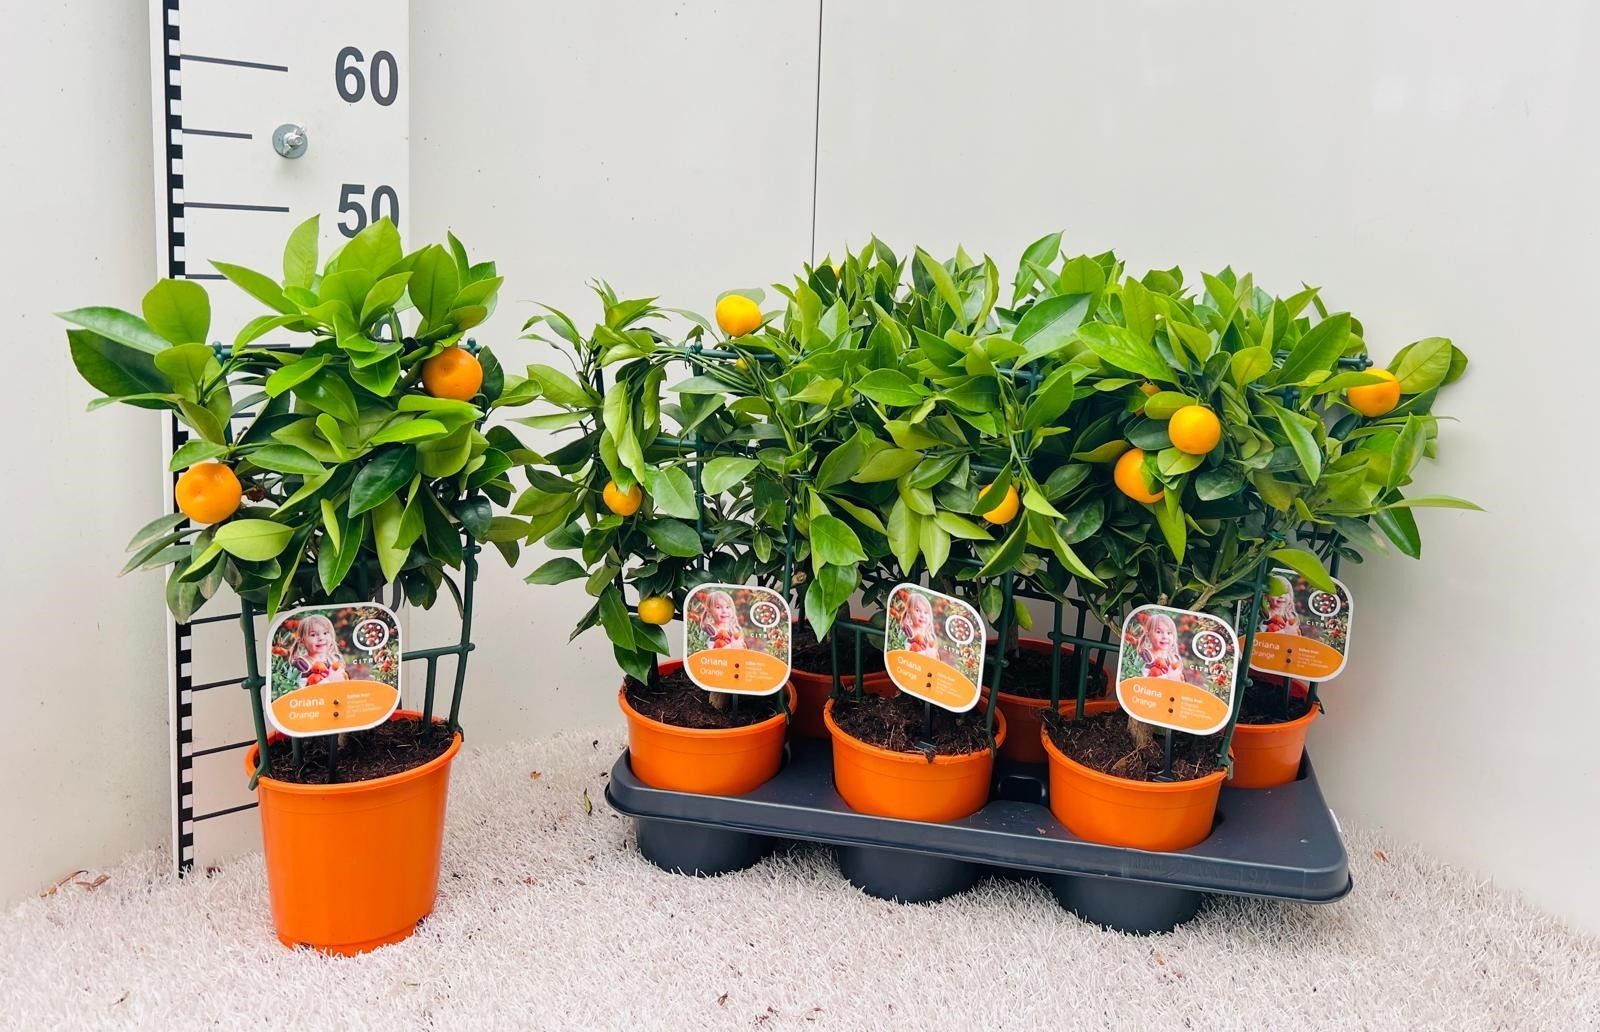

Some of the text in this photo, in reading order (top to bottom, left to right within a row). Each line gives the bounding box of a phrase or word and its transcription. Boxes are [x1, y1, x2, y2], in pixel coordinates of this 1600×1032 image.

[335, 46, 399, 106] 60
[337, 184, 399, 238] 50
[701, 657, 728, 667] Oriana
[1133, 684, 1162, 698] Oriana
[289, 697, 325, 708] Oriana
[1132, 696, 1157, 708] Orange
[289, 709, 320, 720] Orange
